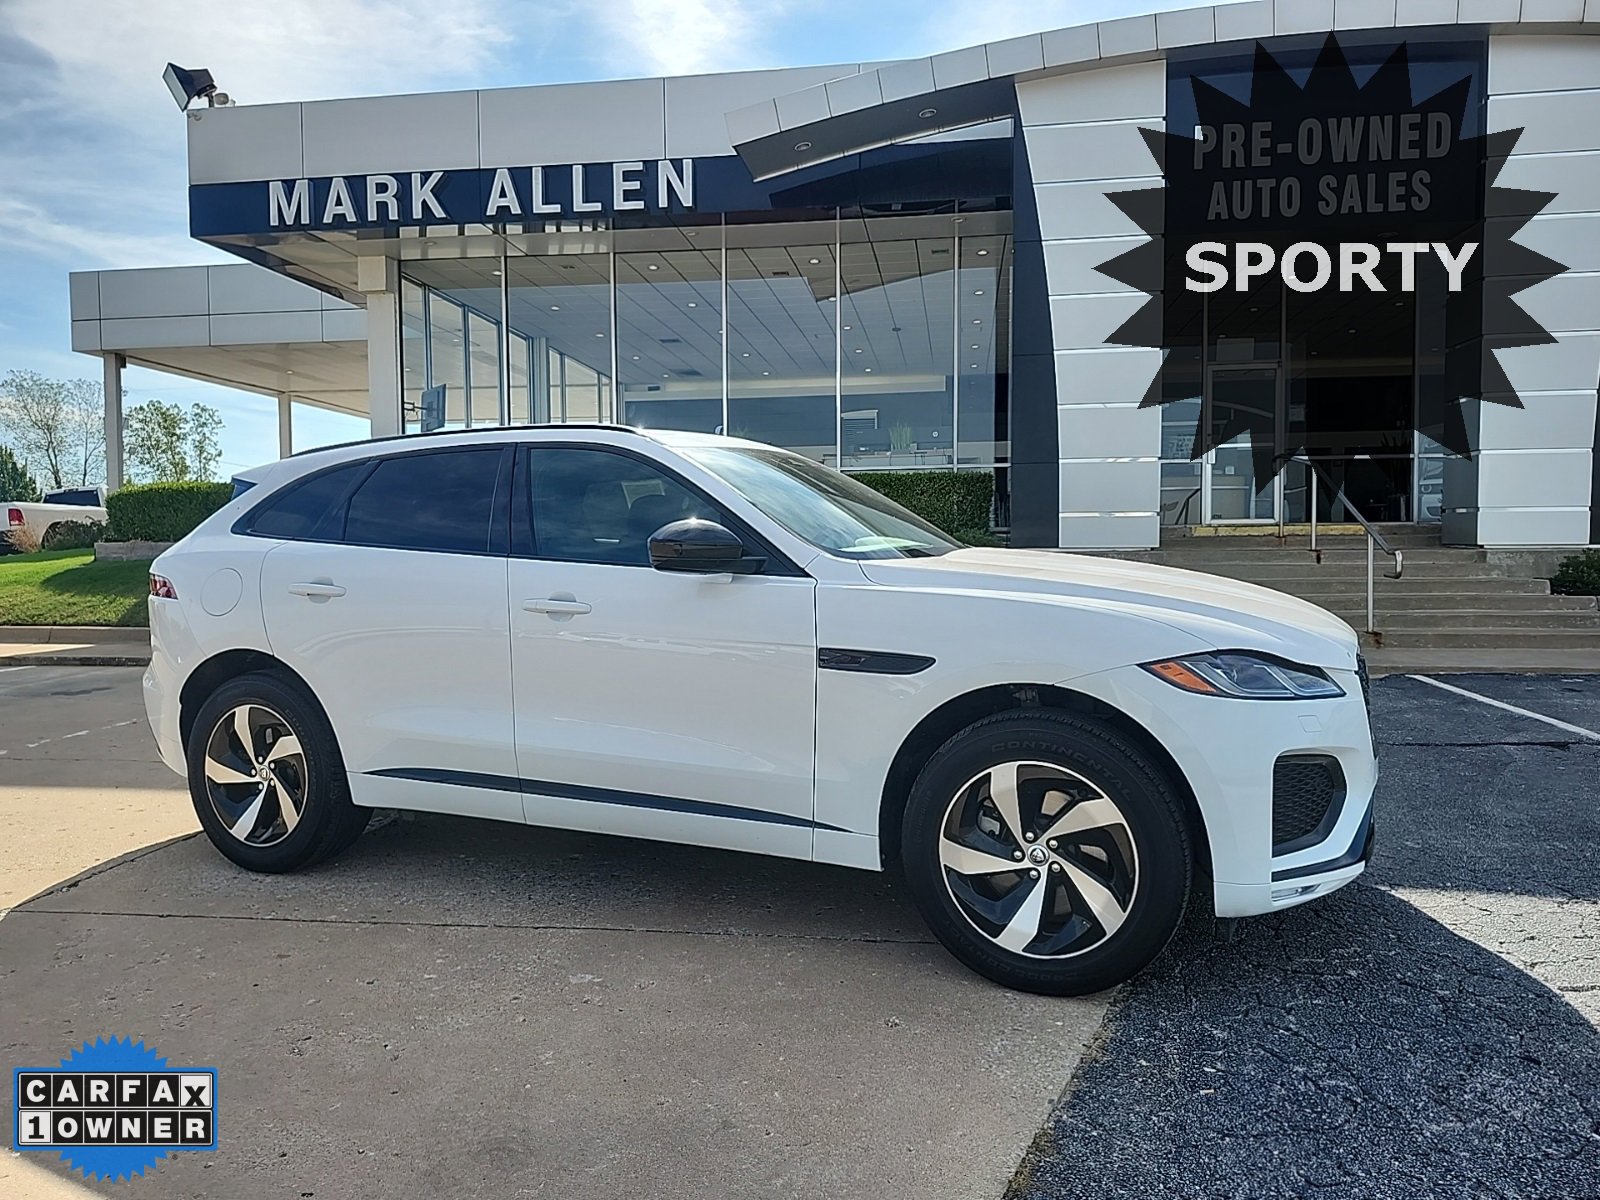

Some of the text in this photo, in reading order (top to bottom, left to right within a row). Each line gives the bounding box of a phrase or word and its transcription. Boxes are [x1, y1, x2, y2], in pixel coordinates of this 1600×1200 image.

[1192, 111, 1452, 170] PRE-OWNED
[268, 158, 694, 226] MARK ALLEN
[1206, 170, 1431, 221] AUTO SALES
[991, 739, 1133, 798] CONTINENTAL
